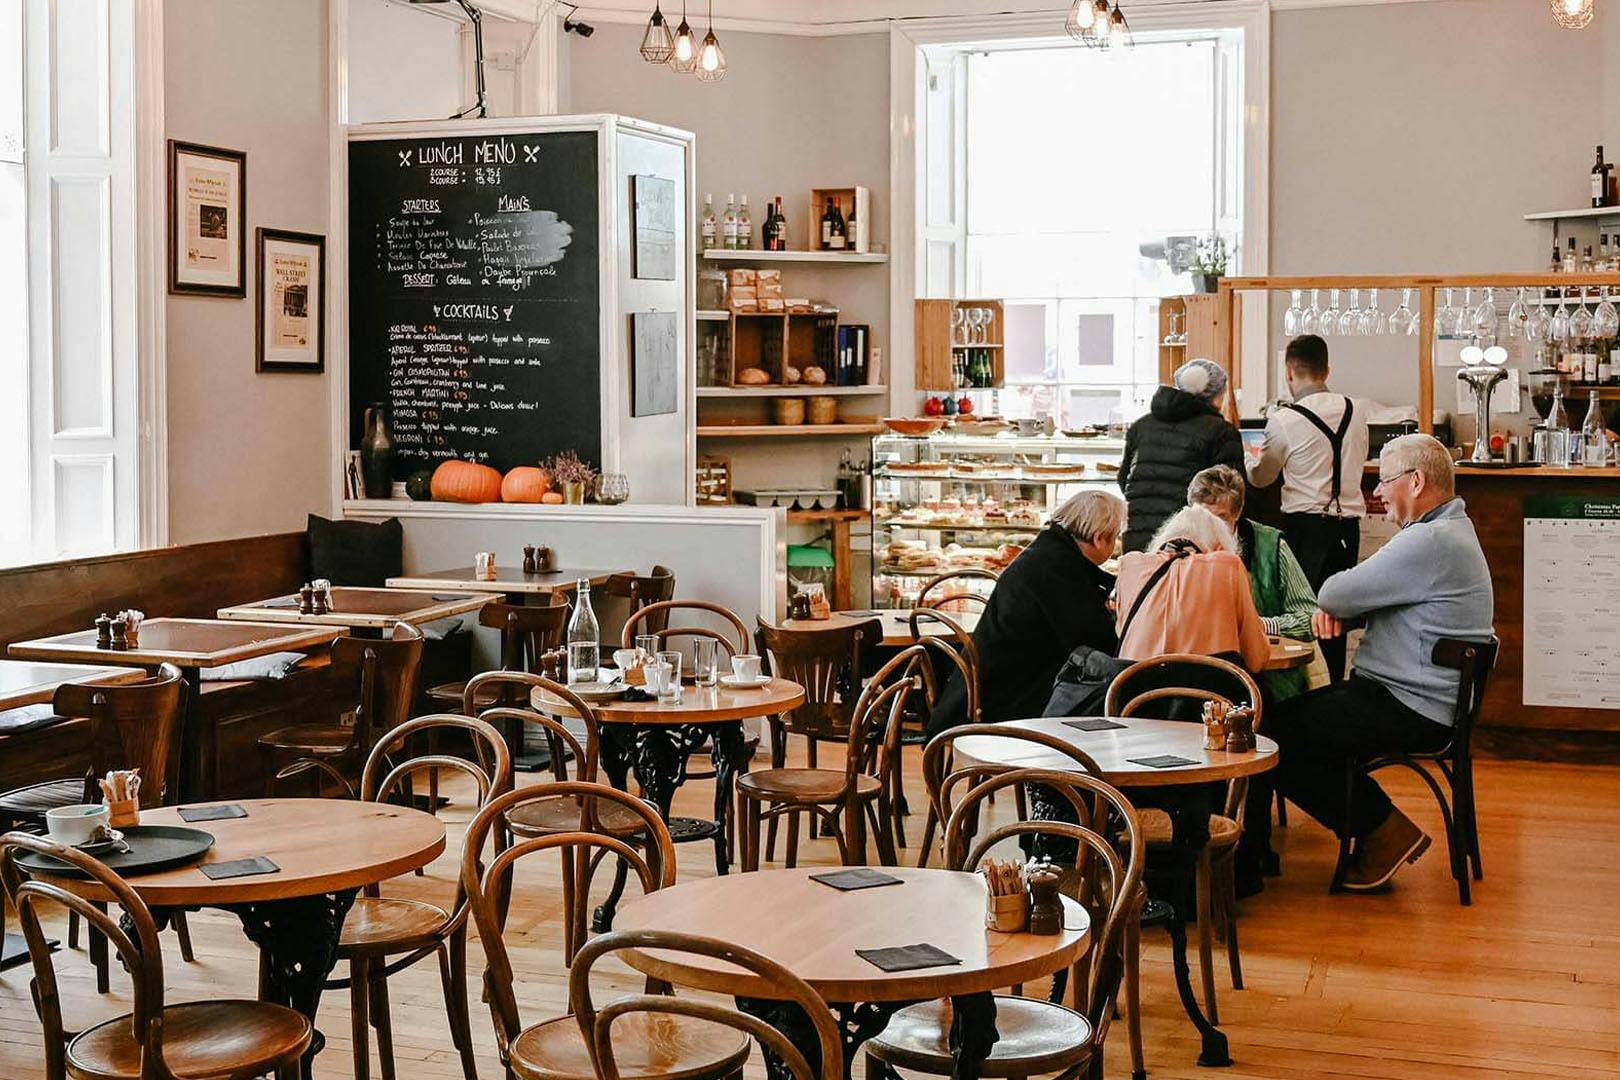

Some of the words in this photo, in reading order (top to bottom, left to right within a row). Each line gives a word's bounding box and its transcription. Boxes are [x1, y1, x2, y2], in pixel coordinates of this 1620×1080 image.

[418, 141, 463, 164] LUNCH
[474, 137, 516, 164] MENU
[402, 199, 441, 213] STARTERS
